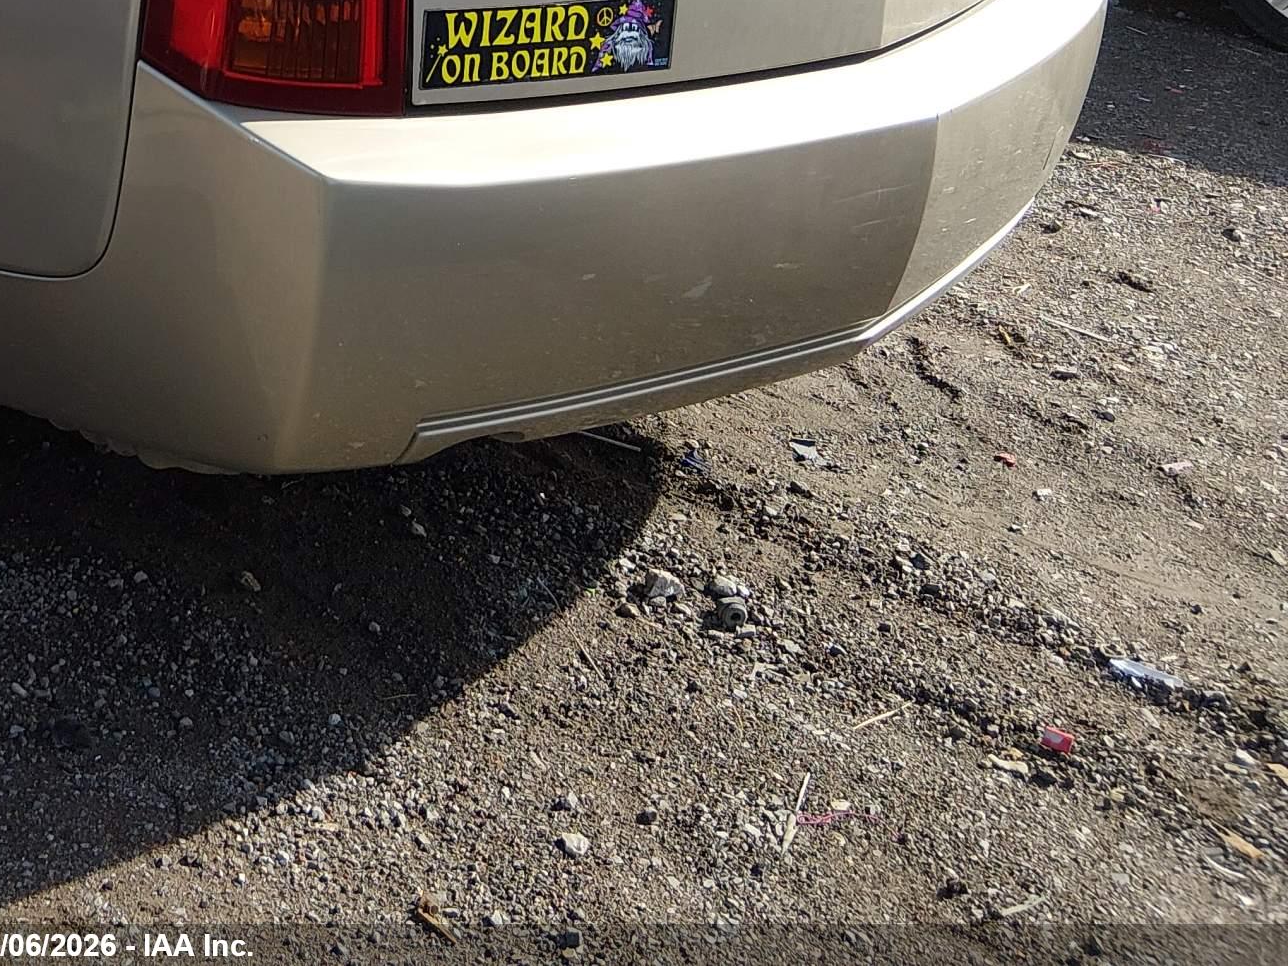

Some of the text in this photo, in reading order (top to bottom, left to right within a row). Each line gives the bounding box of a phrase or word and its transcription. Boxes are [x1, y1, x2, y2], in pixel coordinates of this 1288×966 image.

[445, 5, 589, 49] WIZARD
[441, 45, 587, 84] ON BOARD
